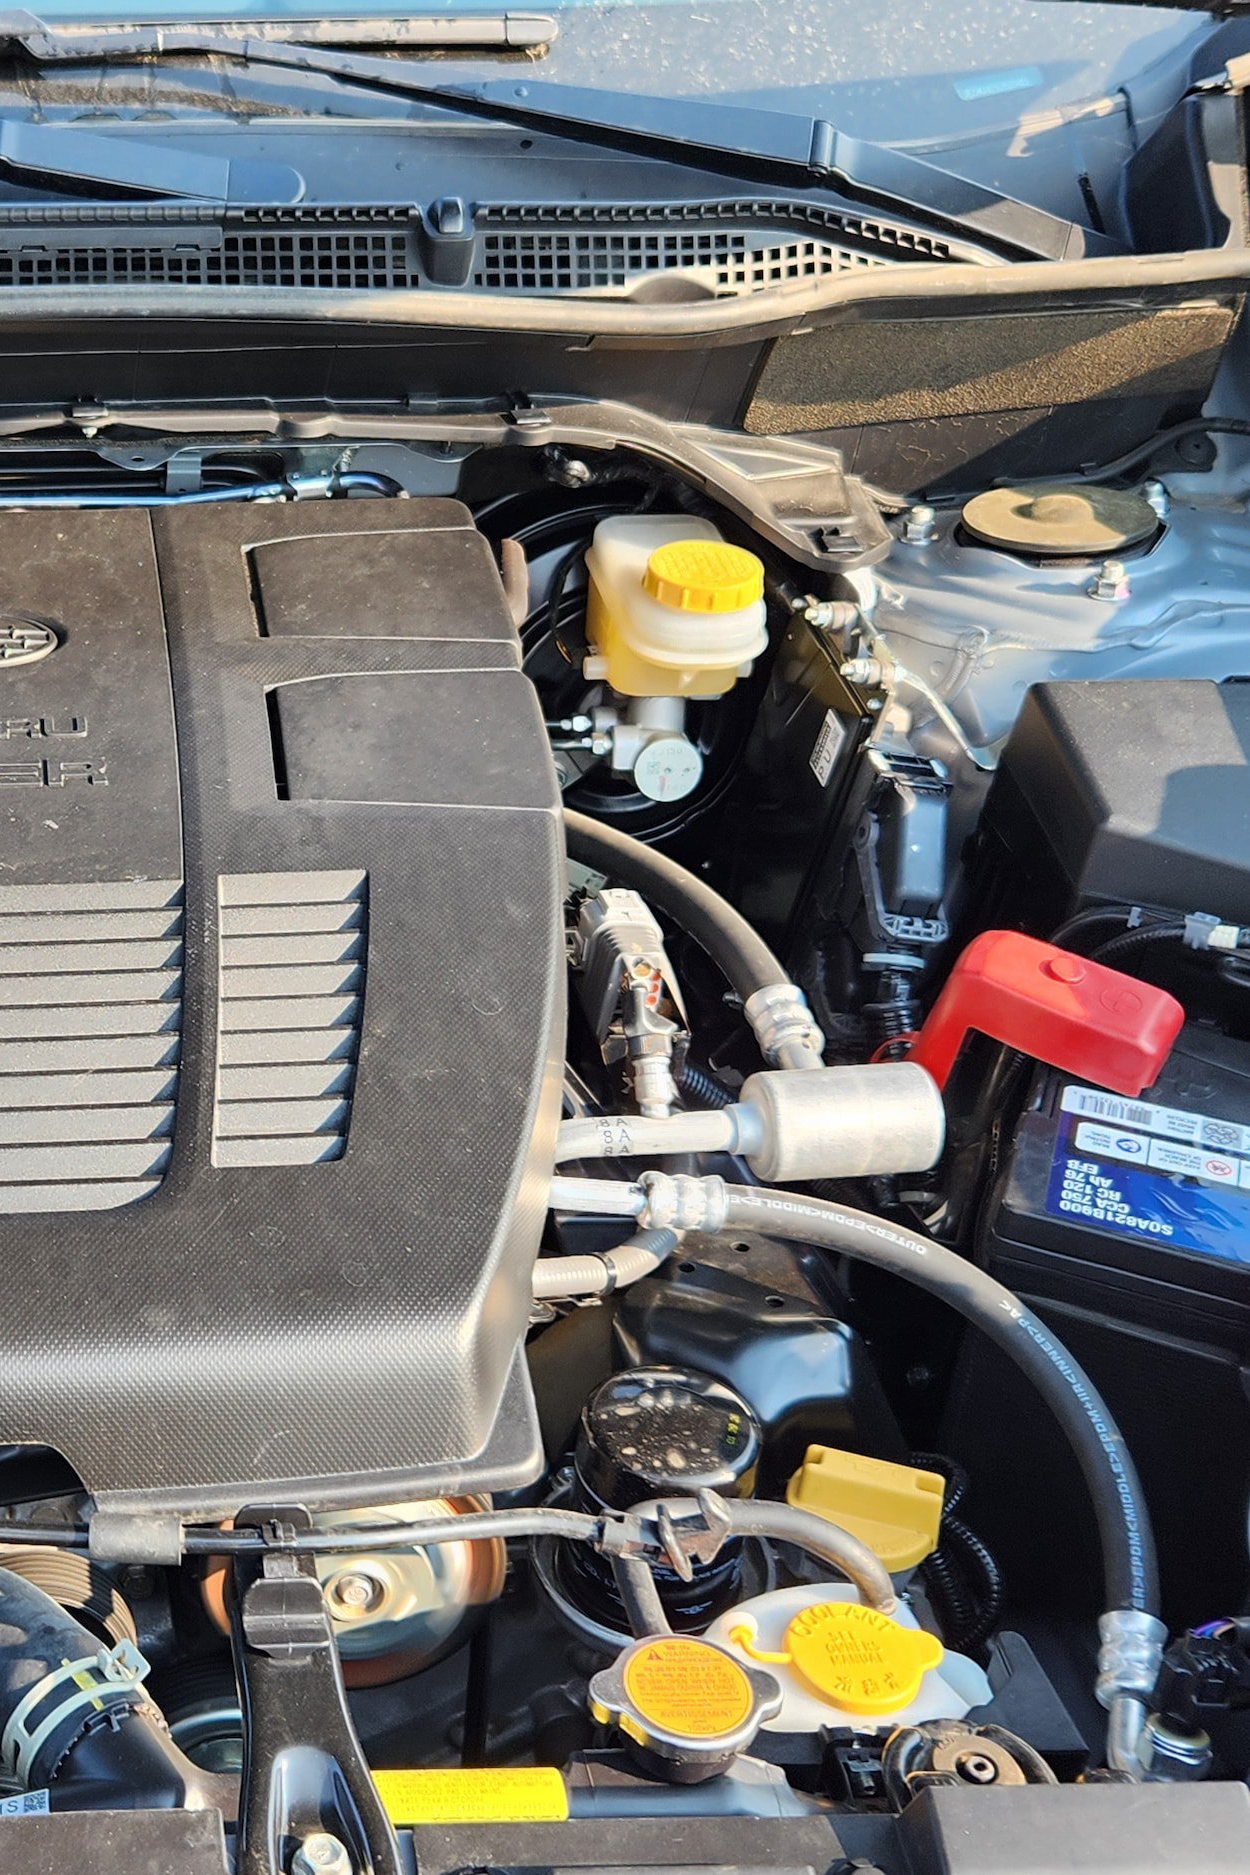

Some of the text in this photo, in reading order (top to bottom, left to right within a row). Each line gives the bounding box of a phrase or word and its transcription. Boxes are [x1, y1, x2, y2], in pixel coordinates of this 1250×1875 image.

[1066, 1159, 1098, 1173] EFB
[1064, 1169, 1112, 1187] Ah 76
[1063, 1179, 1120, 1200] RC 120
[1061, 1189, 1128, 1212] CCA 750
[789, 1605, 893, 1636] COOLANT
[829, 1652, 884, 1665] MANUAL
